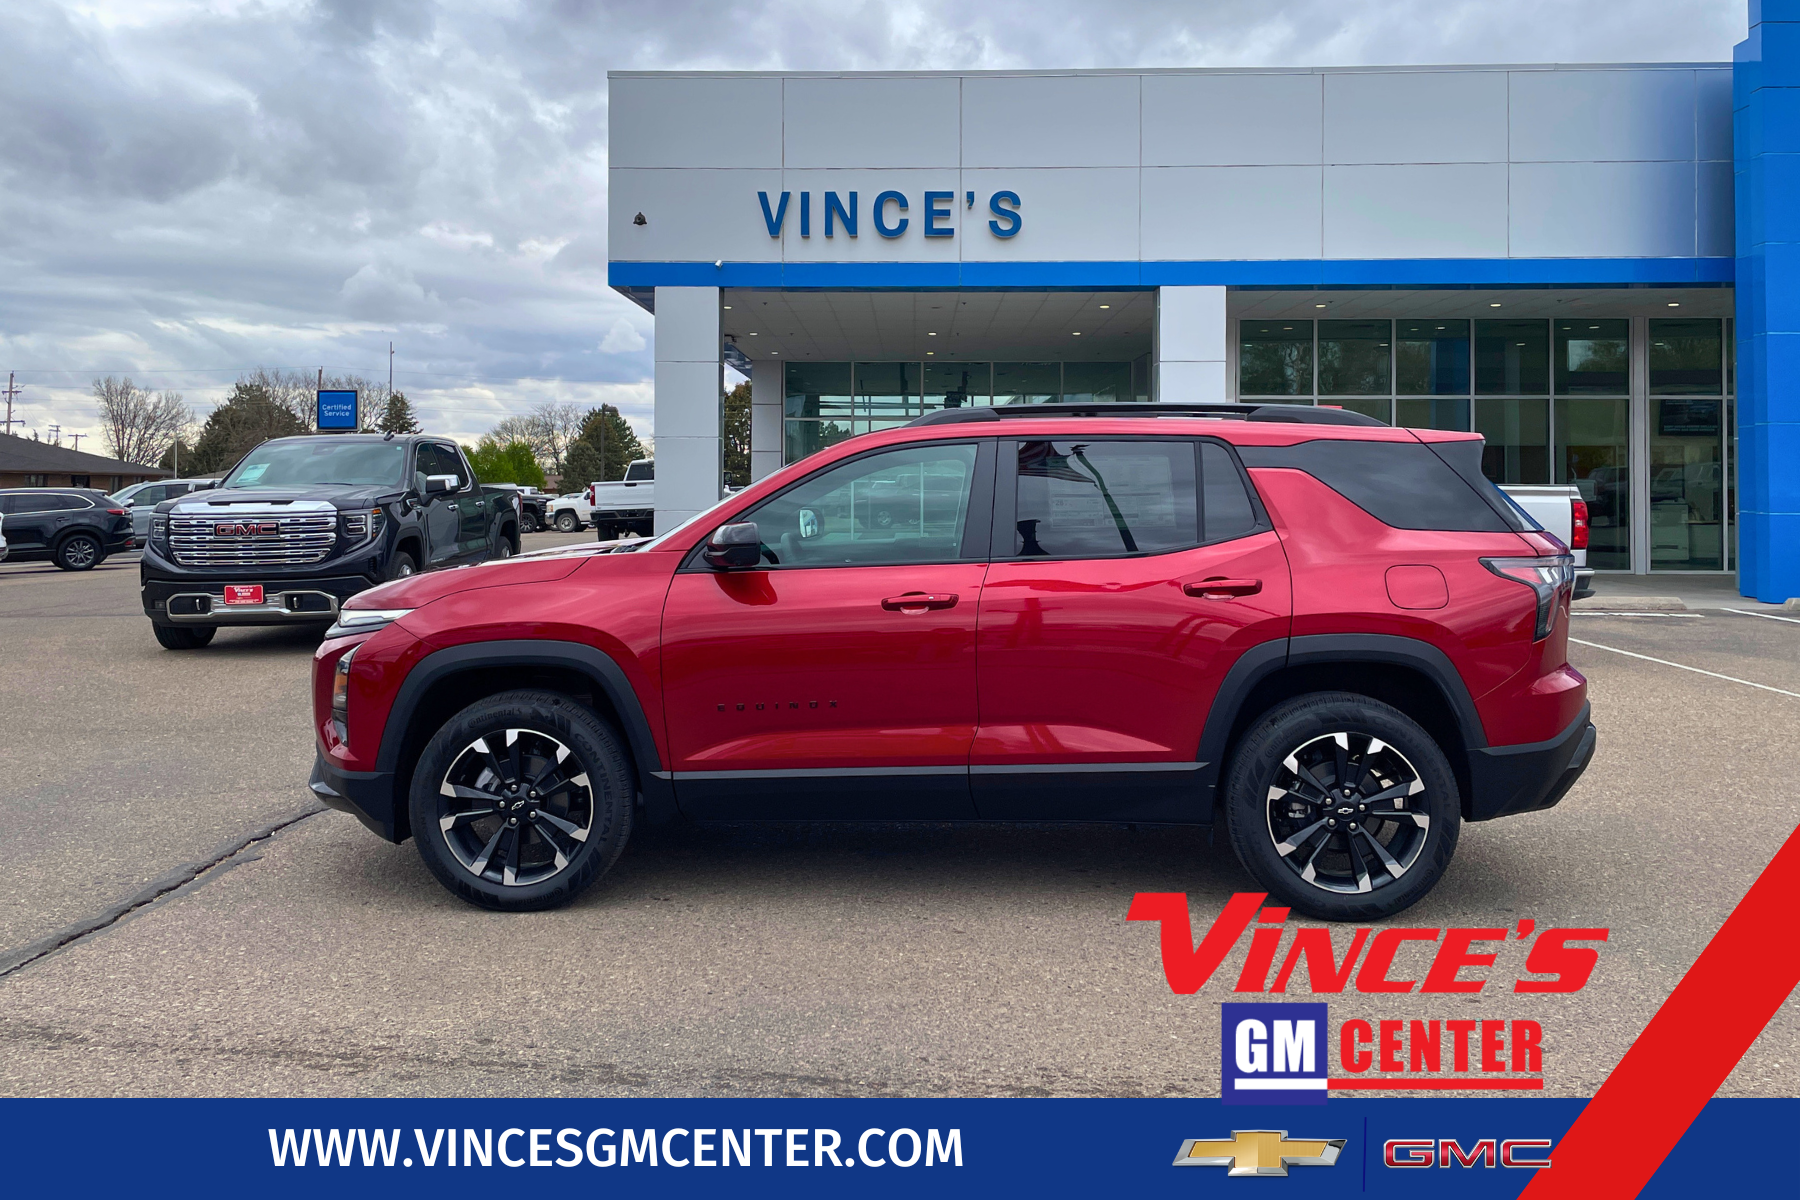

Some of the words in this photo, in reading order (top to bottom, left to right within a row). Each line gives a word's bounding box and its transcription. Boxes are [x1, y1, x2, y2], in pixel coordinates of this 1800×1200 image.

[757, 190, 1023, 239] VINCE'S
[322, 403, 352, 411] Certified
[216, 523, 277, 536] GMC
[717, 700, 837, 712] EQUINOX
[467, 707, 515, 729] Continental
[574, 732, 613, 845] CONTINENTAL
